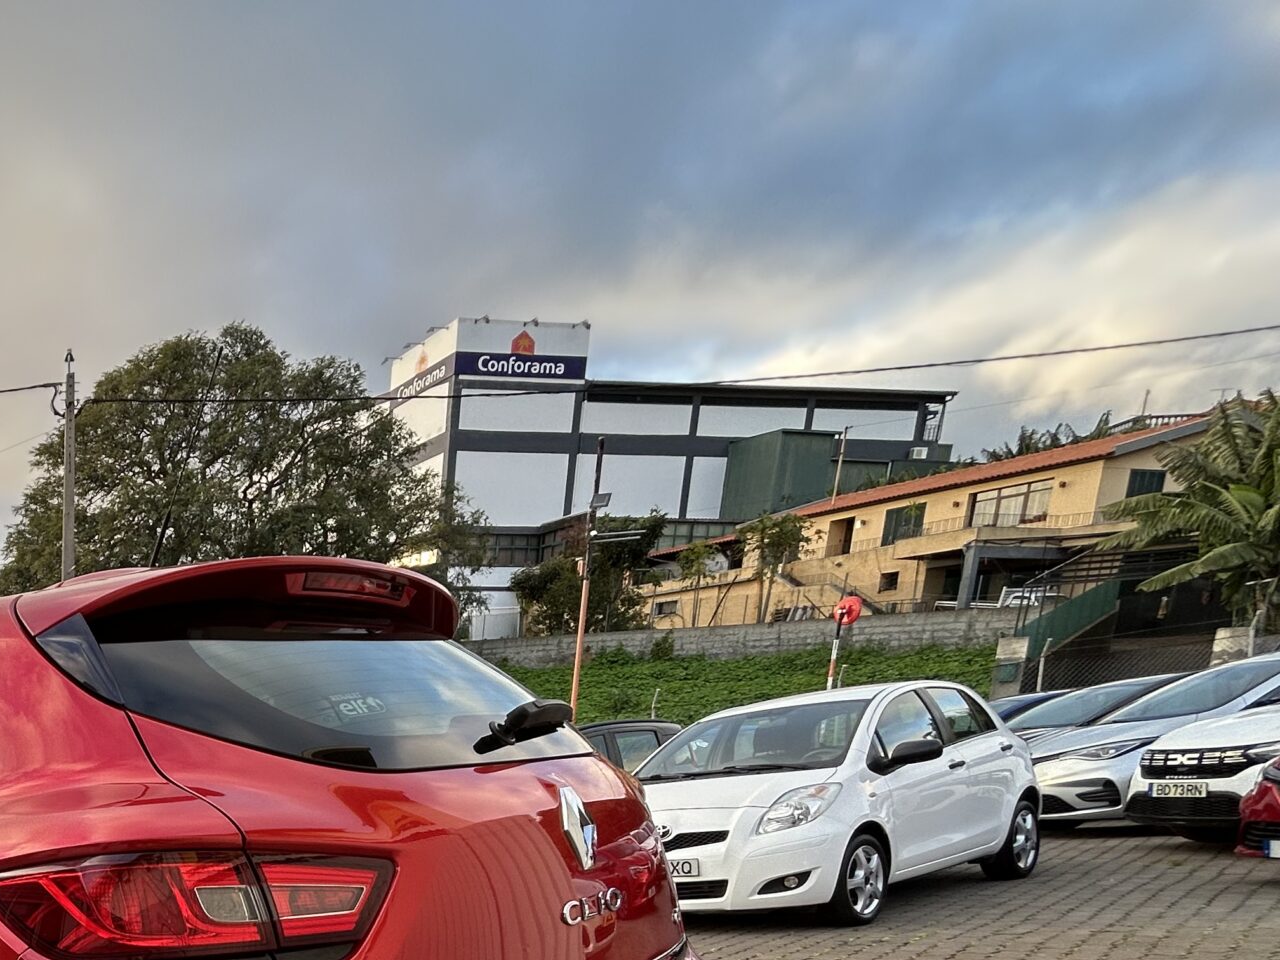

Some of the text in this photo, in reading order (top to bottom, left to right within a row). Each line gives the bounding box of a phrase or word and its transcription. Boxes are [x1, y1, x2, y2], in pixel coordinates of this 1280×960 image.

[477, 355, 565, 375] Conforama
[397, 365, 447, 402] Conforama
[339, 699, 369, 715] elf
[561, 887, 622, 926] CLIO
